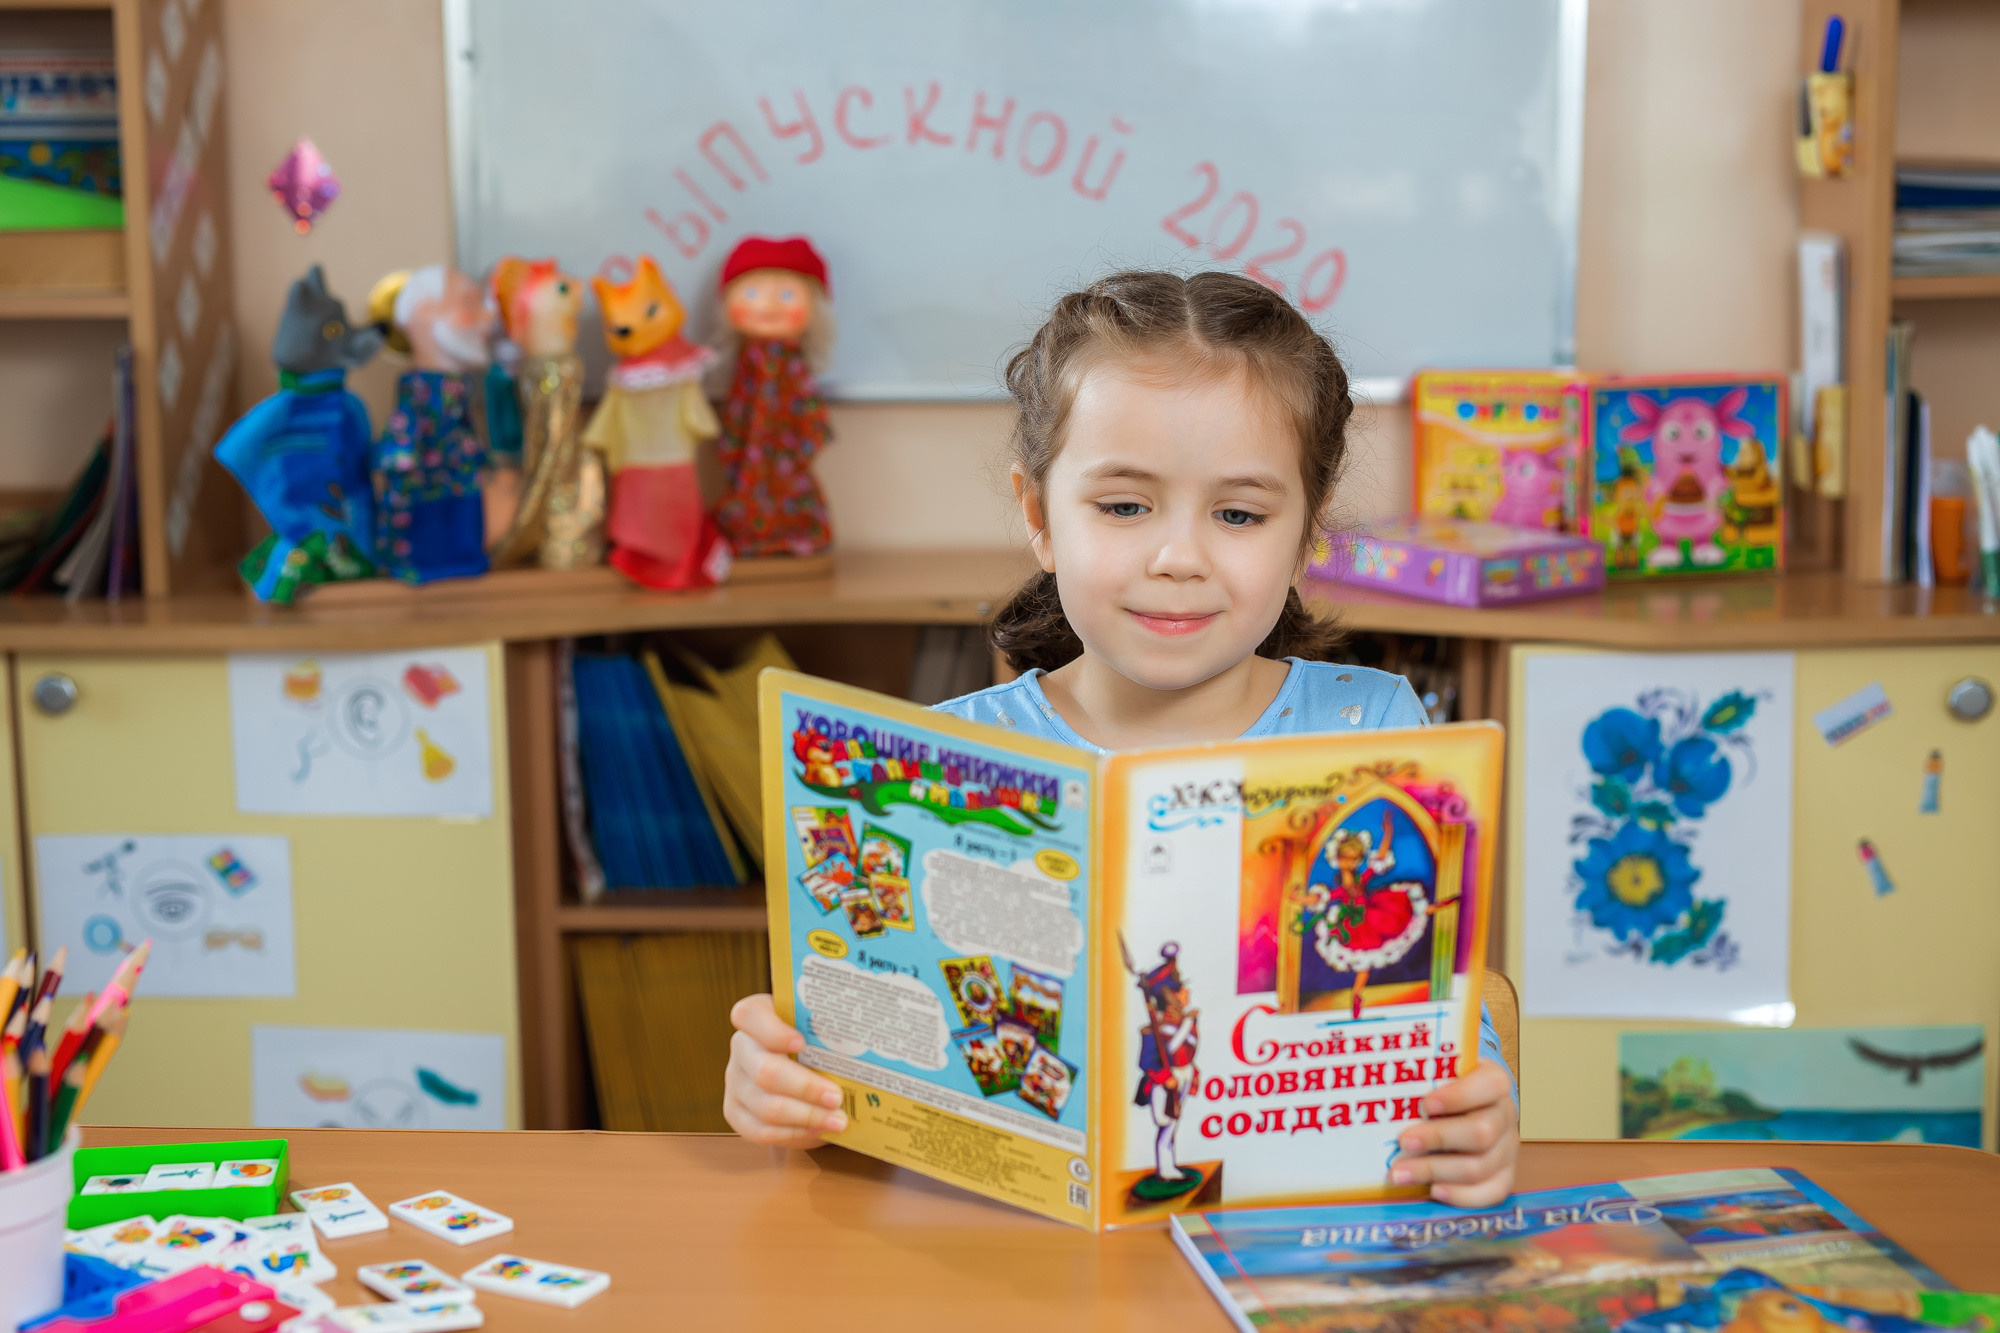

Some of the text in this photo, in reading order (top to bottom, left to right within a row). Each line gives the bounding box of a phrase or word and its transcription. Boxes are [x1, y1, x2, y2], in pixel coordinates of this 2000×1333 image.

[1161, 161, 1348, 313] 2020
[1230, 1003, 1430, 1066] Стойкий
[1204, 1042, 1460, 1101] оловянный
[1200, 1094, 1428, 1139] солдати
[1300, 1195, 1663, 1248] Для рисования
